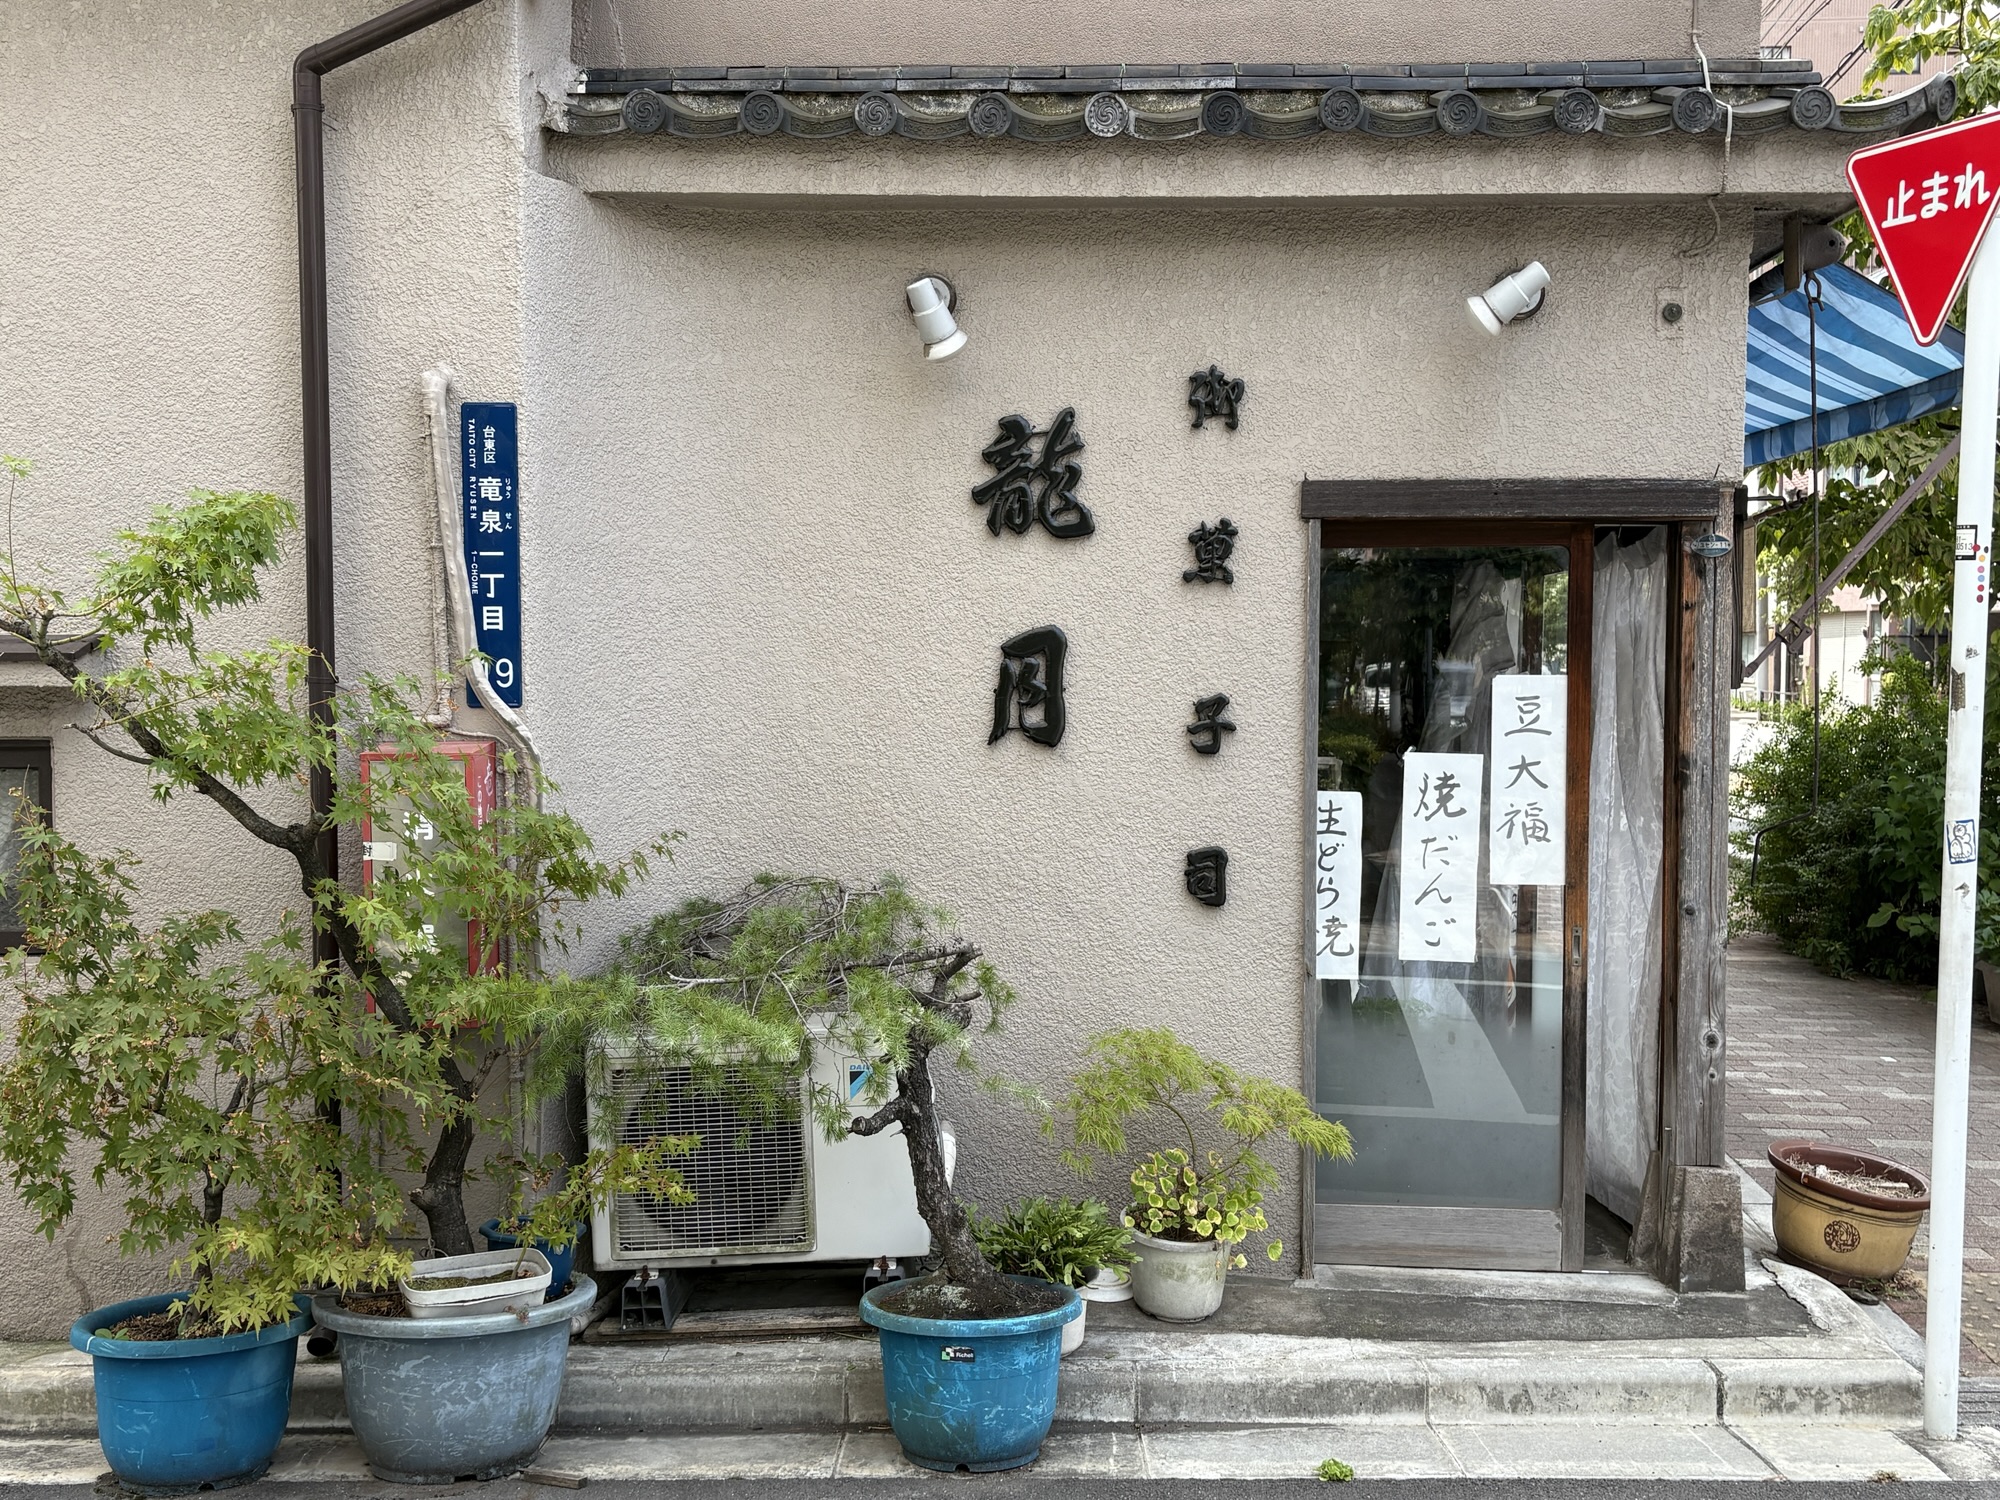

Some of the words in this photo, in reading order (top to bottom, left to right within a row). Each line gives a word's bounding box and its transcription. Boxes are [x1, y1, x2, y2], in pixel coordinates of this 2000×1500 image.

[1881, 162, 1990, 229] 止まれ
[468, 418, 476, 445] TAITO
[482, 425, 496, 464] 台東区
[469, 476, 477, 519] RYUSEN
[971, 406, 1095, 748] 龍月
[1496, 695, 1552, 845] 豆大福
[1413, 770, 1468, 947] 焼だんご
